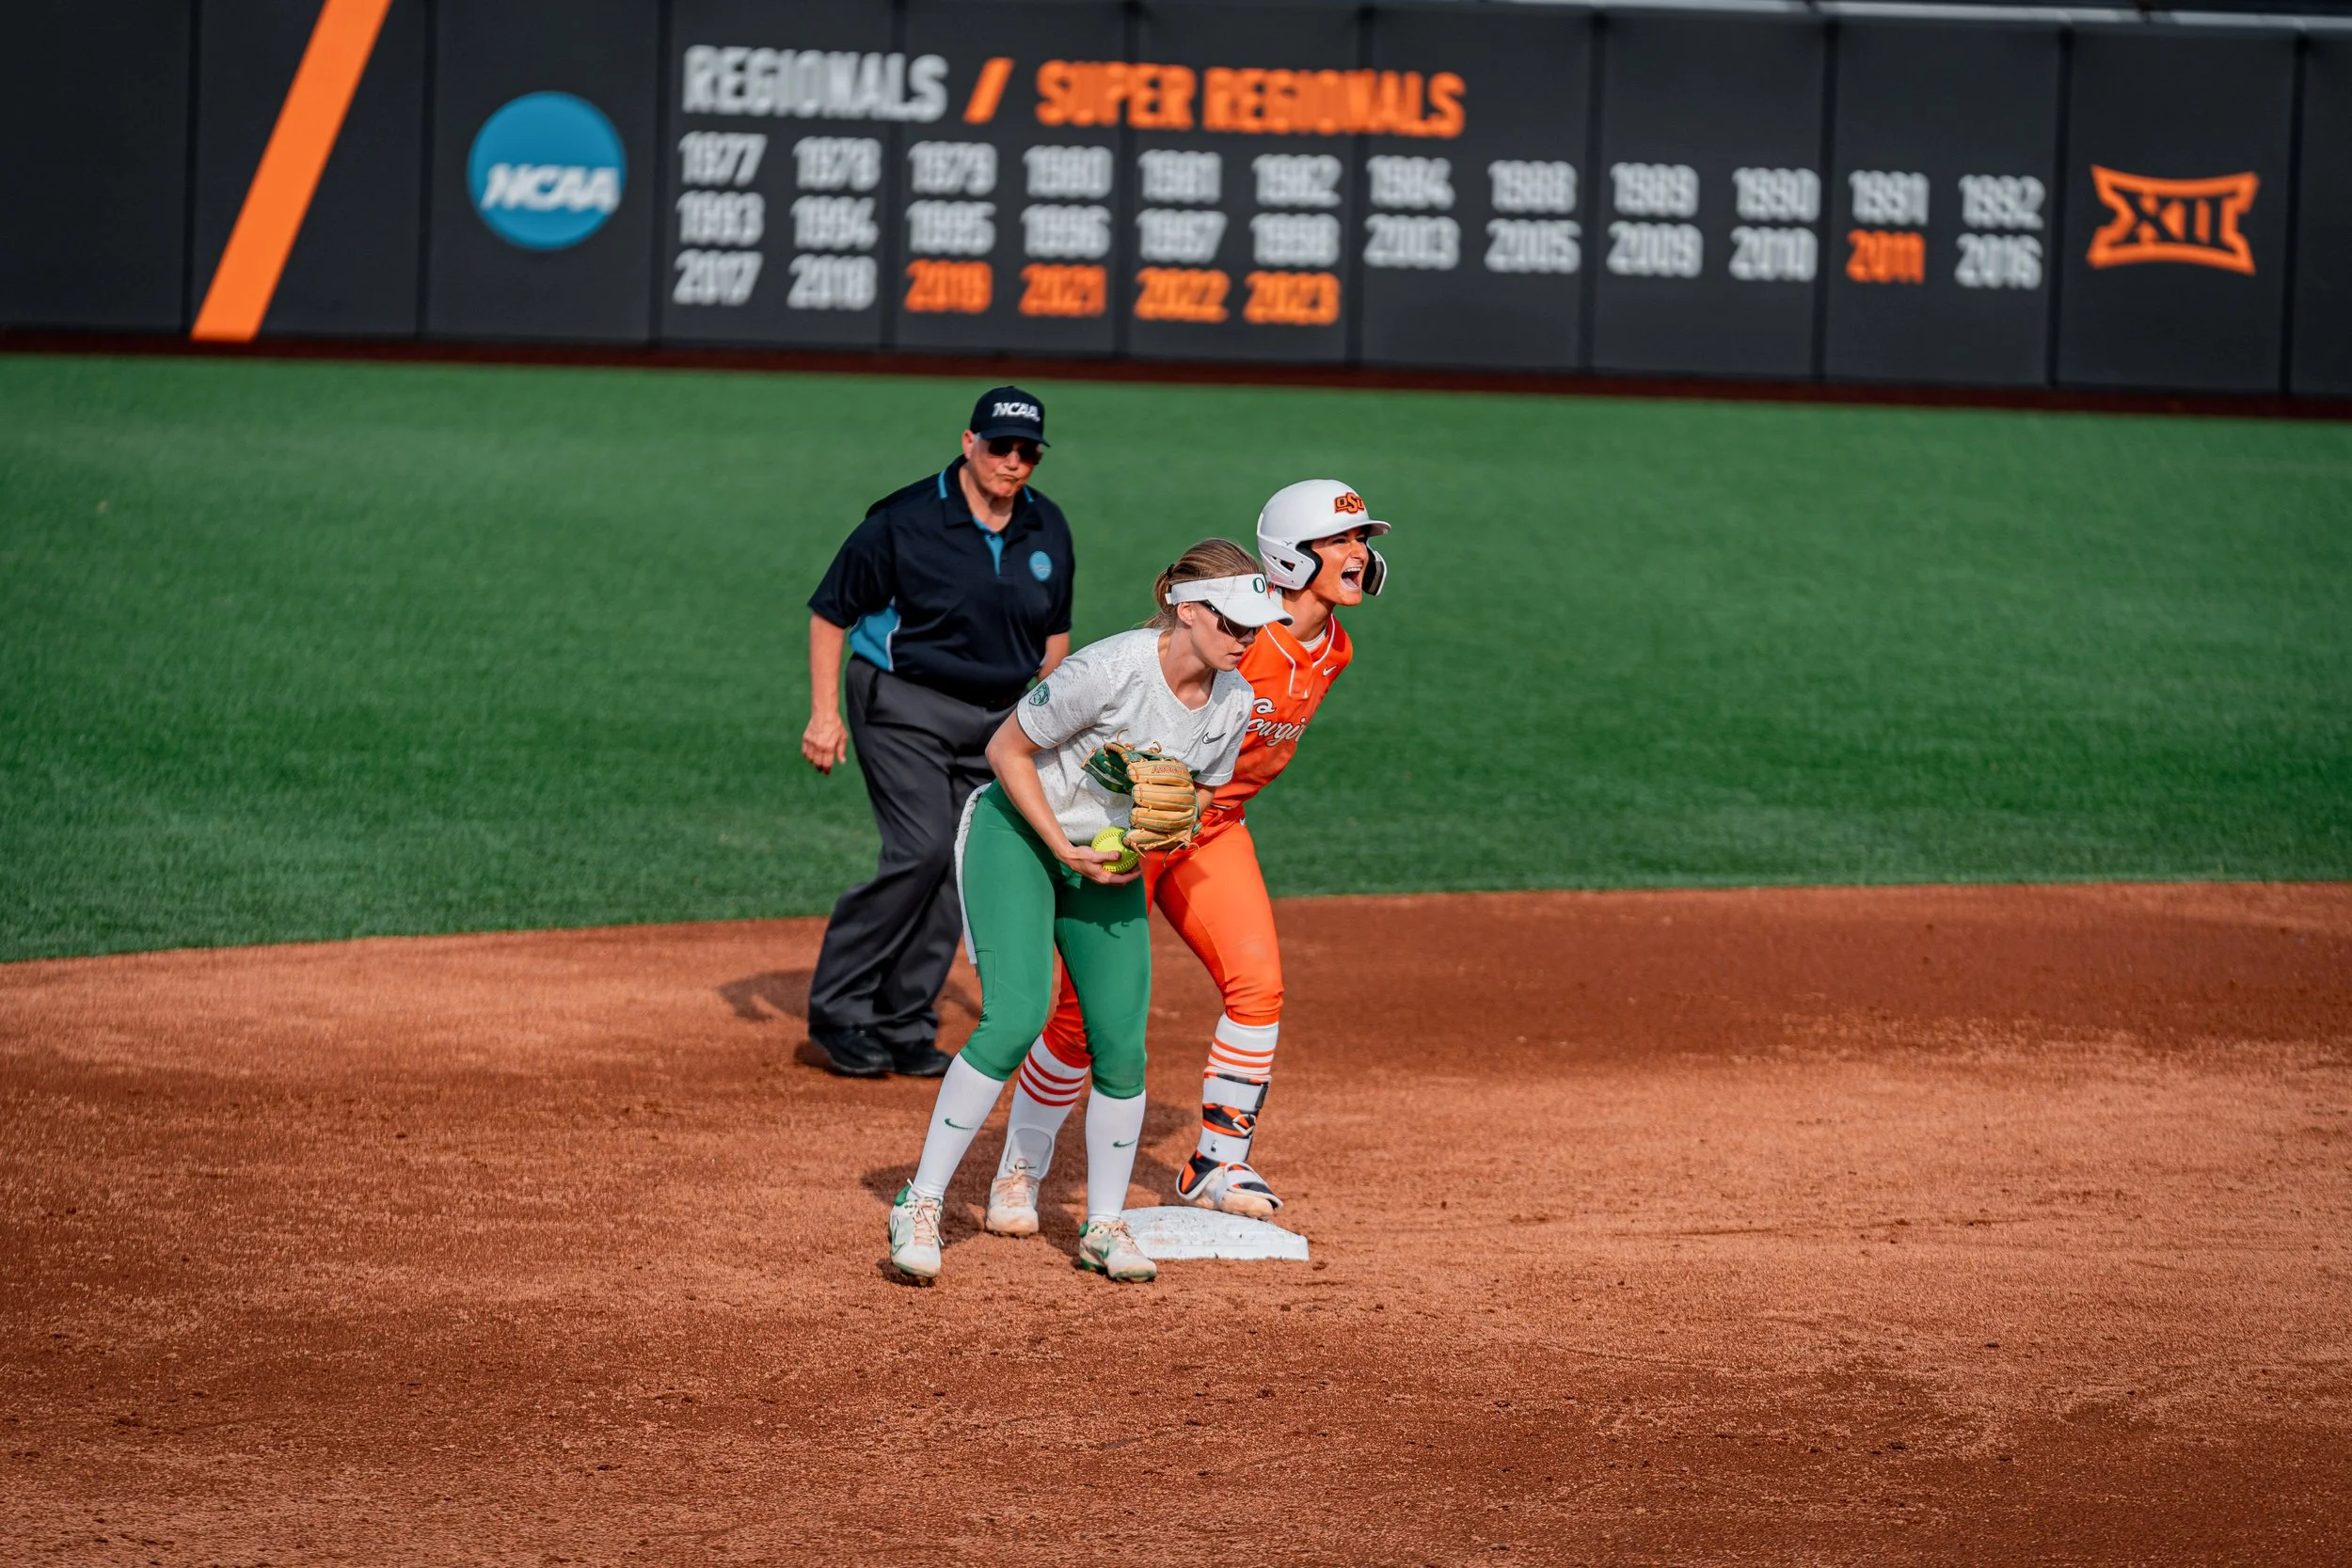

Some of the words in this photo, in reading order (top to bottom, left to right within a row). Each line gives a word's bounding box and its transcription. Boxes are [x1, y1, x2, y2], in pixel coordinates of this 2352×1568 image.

[684, 45, 947, 122] REGIONALS
[1037, 60, 1195, 129] SUPER
[1203, 67, 1466, 138] REGIONALS
[481, 164, 621, 214] NCAA
[679, 132, 766, 184] 1977
[794, 137, 881, 189] 1978
[909, 141, 995, 194] 1979
[1024, 146, 1112, 198] 1980
[1138, 150, 1221, 202] 1981
[1253, 154, 1342, 206] 1982
[1368, 156, 1454, 208] 1984
[1611, 163, 1698, 216] 1989
[1734, 168, 1820, 220] 1990
[1850, 171, 1929, 224] 1991
[1960, 176, 2044, 228] 1992
[676, 192, 764, 245] 1993
[791, 197, 878, 248] 1994
[906, 200, 994, 254] 1995
[1022, 205, 1109, 258] 1996
[1136, 209, 1226, 261] 1997
[1364, 214, 1459, 269] 2003
[1486, 219, 1581, 273] 2005
[1608, 222, 1703, 277] 2009
[1730, 227, 1817, 280] 2010
[1847, 230, 1925, 283] 2011
[1956, 234, 2042, 288] 2016
[674, 250, 762, 305] 2017
[788, 255, 876, 309] 2018
[904, 260, 992, 312] 2019
[1019, 263, 1106, 317] 2021
[1135, 267, 1230, 322] 2022
[1244, 271, 1341, 325] 2023
[992, 402, 1041, 421] NCAA
[1334, 492, 1365, 515] OSU
[1253, 577, 1265, 594] O
